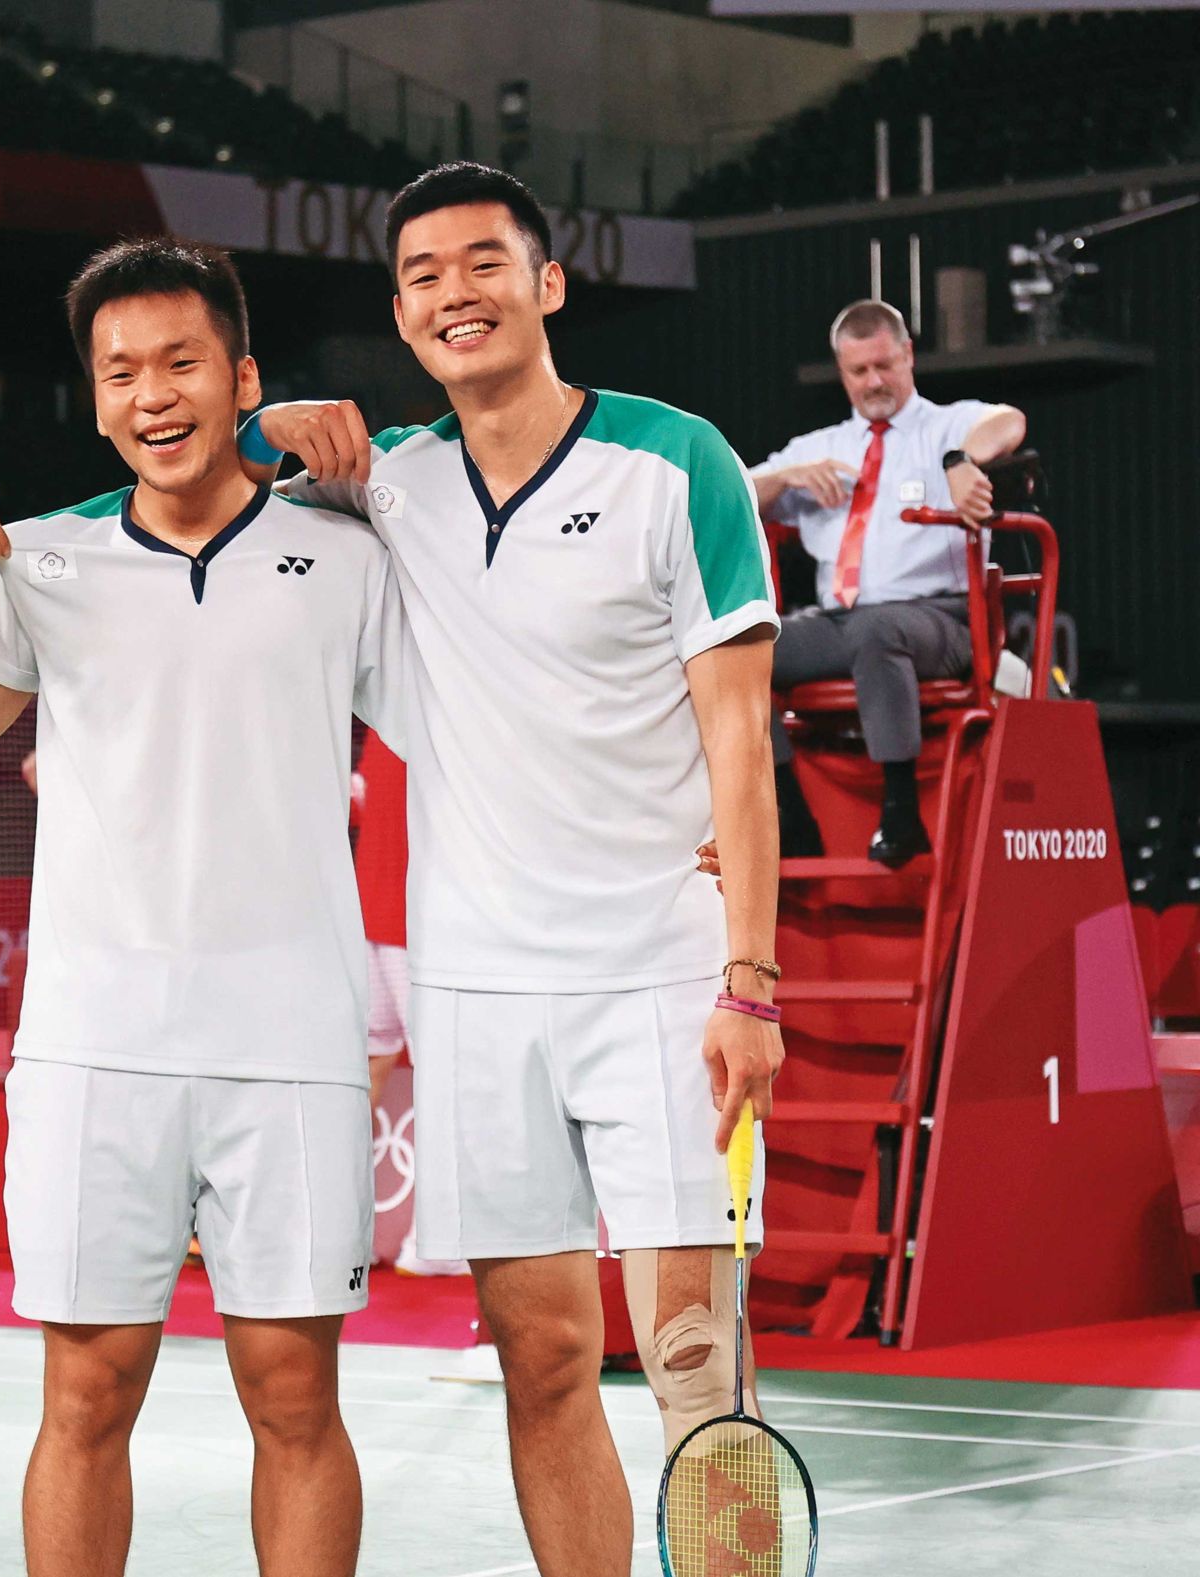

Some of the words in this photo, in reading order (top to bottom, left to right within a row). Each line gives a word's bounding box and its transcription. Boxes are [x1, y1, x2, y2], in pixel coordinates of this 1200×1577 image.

[256, 176, 383, 263] TOK
[557, 202, 624, 284] 20
[1003, 829, 1062, 860] TOKYO
[1064, 828, 1107, 859] 2020
[1043, 1055, 1060, 1124] 1
